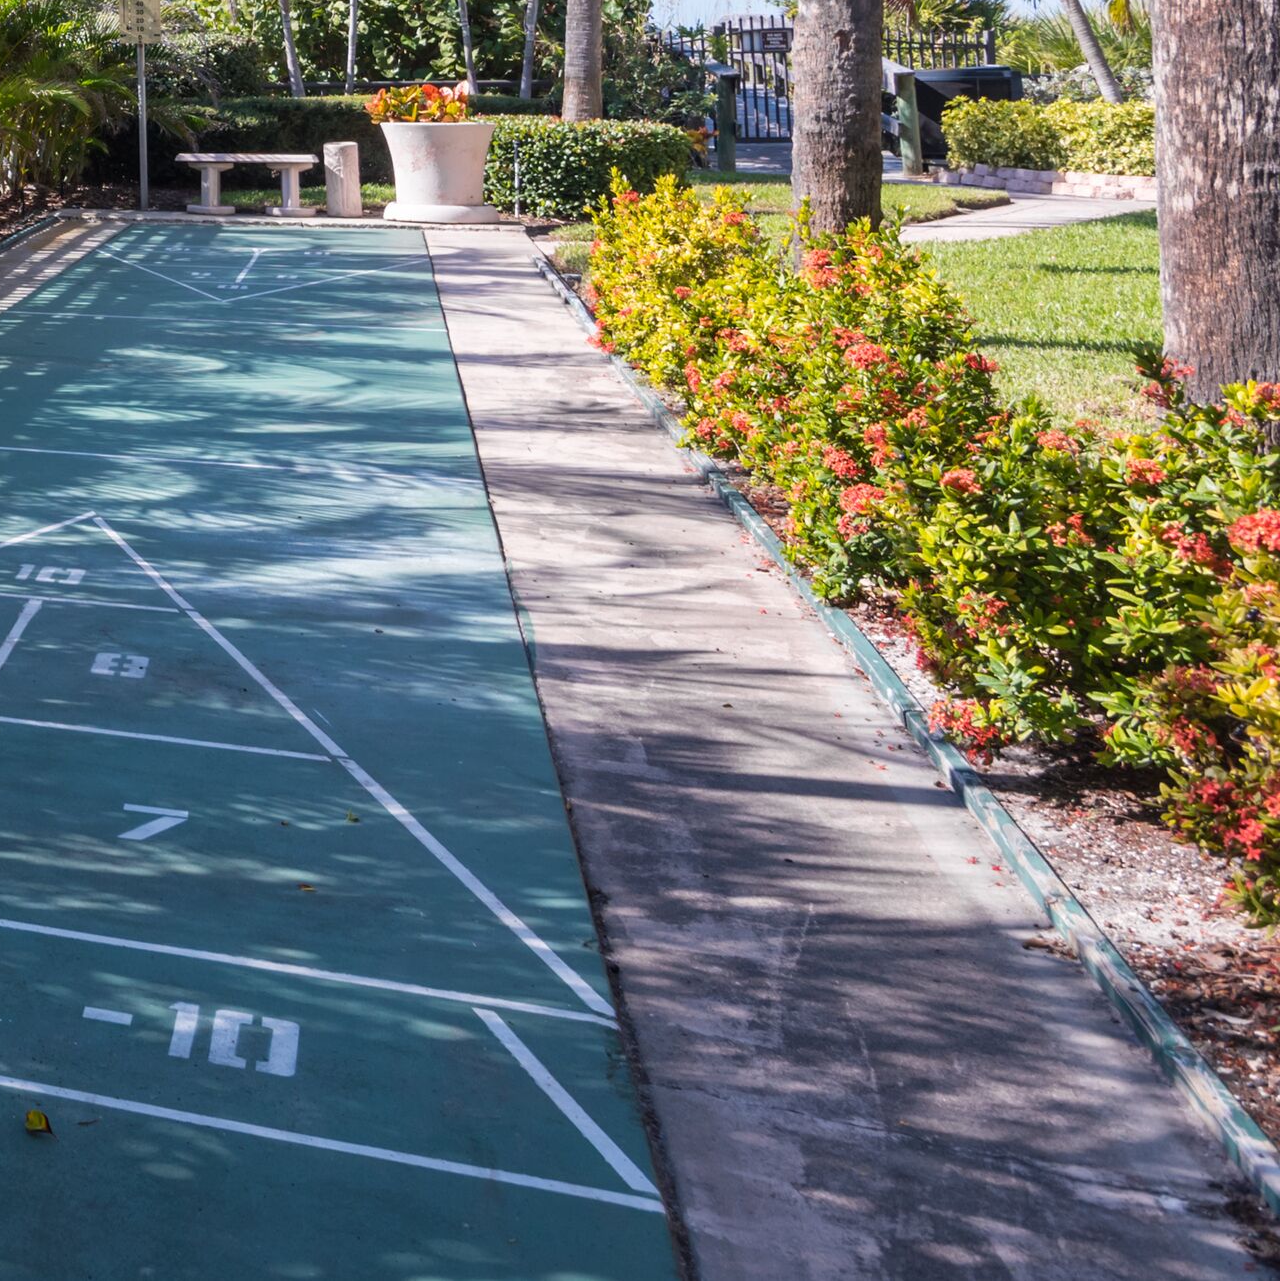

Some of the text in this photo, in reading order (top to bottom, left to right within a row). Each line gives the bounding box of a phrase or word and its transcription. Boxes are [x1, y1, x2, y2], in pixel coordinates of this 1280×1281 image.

[15, 563, 87, 585] 10
[90, 652, 150, 679] 8
[117, 803, 189, 840] 7
